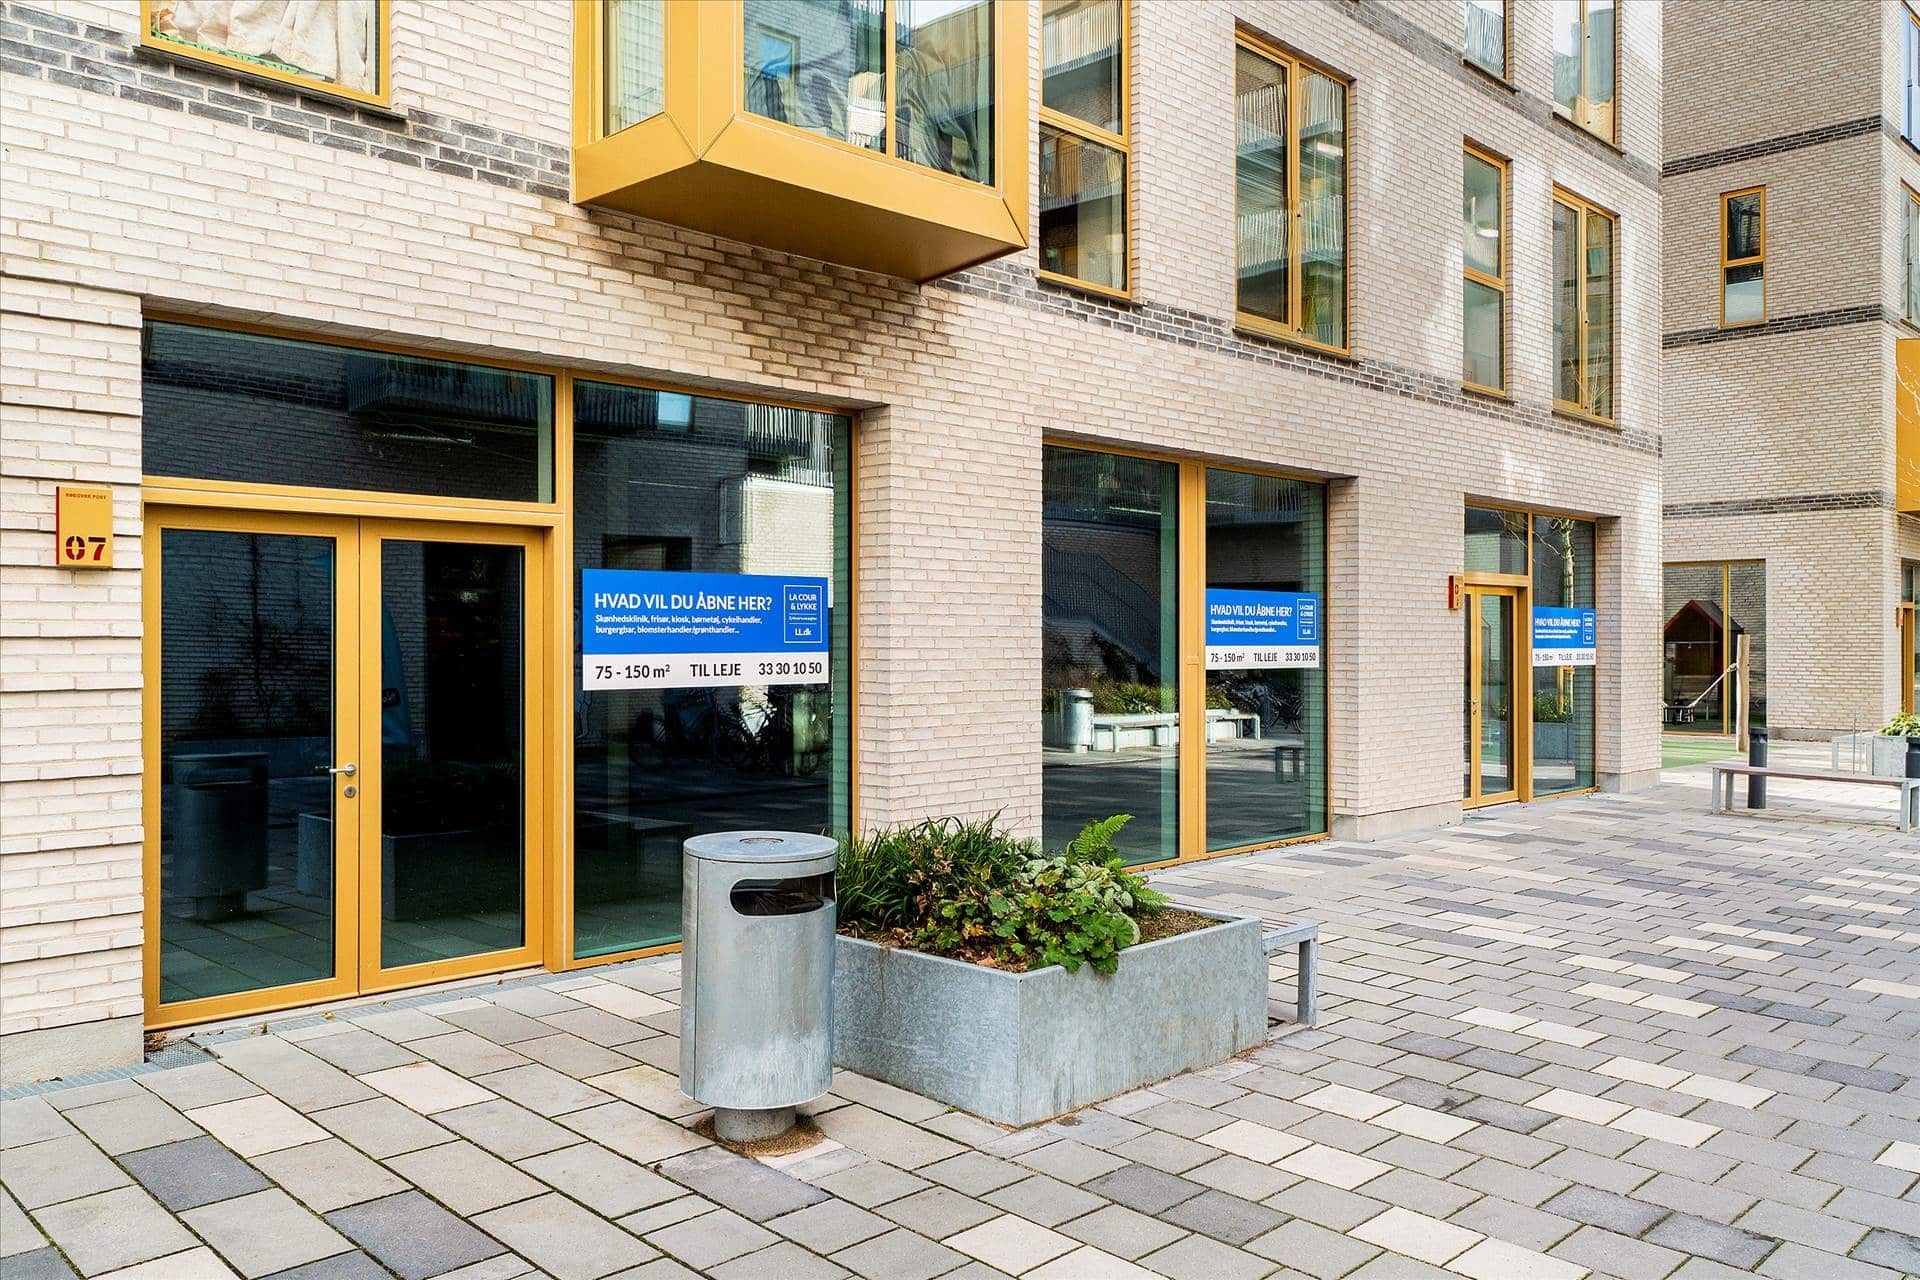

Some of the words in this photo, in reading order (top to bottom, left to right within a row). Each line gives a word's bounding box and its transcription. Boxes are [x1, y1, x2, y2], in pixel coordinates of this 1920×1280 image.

[66, 536, 106, 560] 07
[594, 593, 641, 609] HVAD
[643, 594, 668, 609] VIL
[671, 594, 693, 610] DU
[696, 592, 736, 610] ÅBNE
[738, 596, 772, 610] HER?
[1210, 604, 1232, 616] HVAD
[1232, 605, 1244, 616] VIL
[1245, 606, 1256, 616] DU
[1256, 603, 1275, 616] ÅBNE
[1276, 606, 1293, 616] HER?
[595, 614, 650, 623] Skønhedsklinik,
[650, 615, 670, 623] frisør,
[1210, 653, 1218, 662] 75
[1224, 653, 1236, 662] 150
[1254, 653, 1263, 662] TIL
[1264, 652, 1278, 662] LEJE
[595, 666, 612, 679] 75
[625, 664, 650, 678] 150
[653, 664, 670, 678] m²
[690, 664, 710, 677] TIL
[713, 664, 742, 676] LEJE
[759, 663, 773, 675] 33
[776, 663, 790, 675] 30
[794, 663, 807, 674] 10
[808, 662, 822, 674] 50
